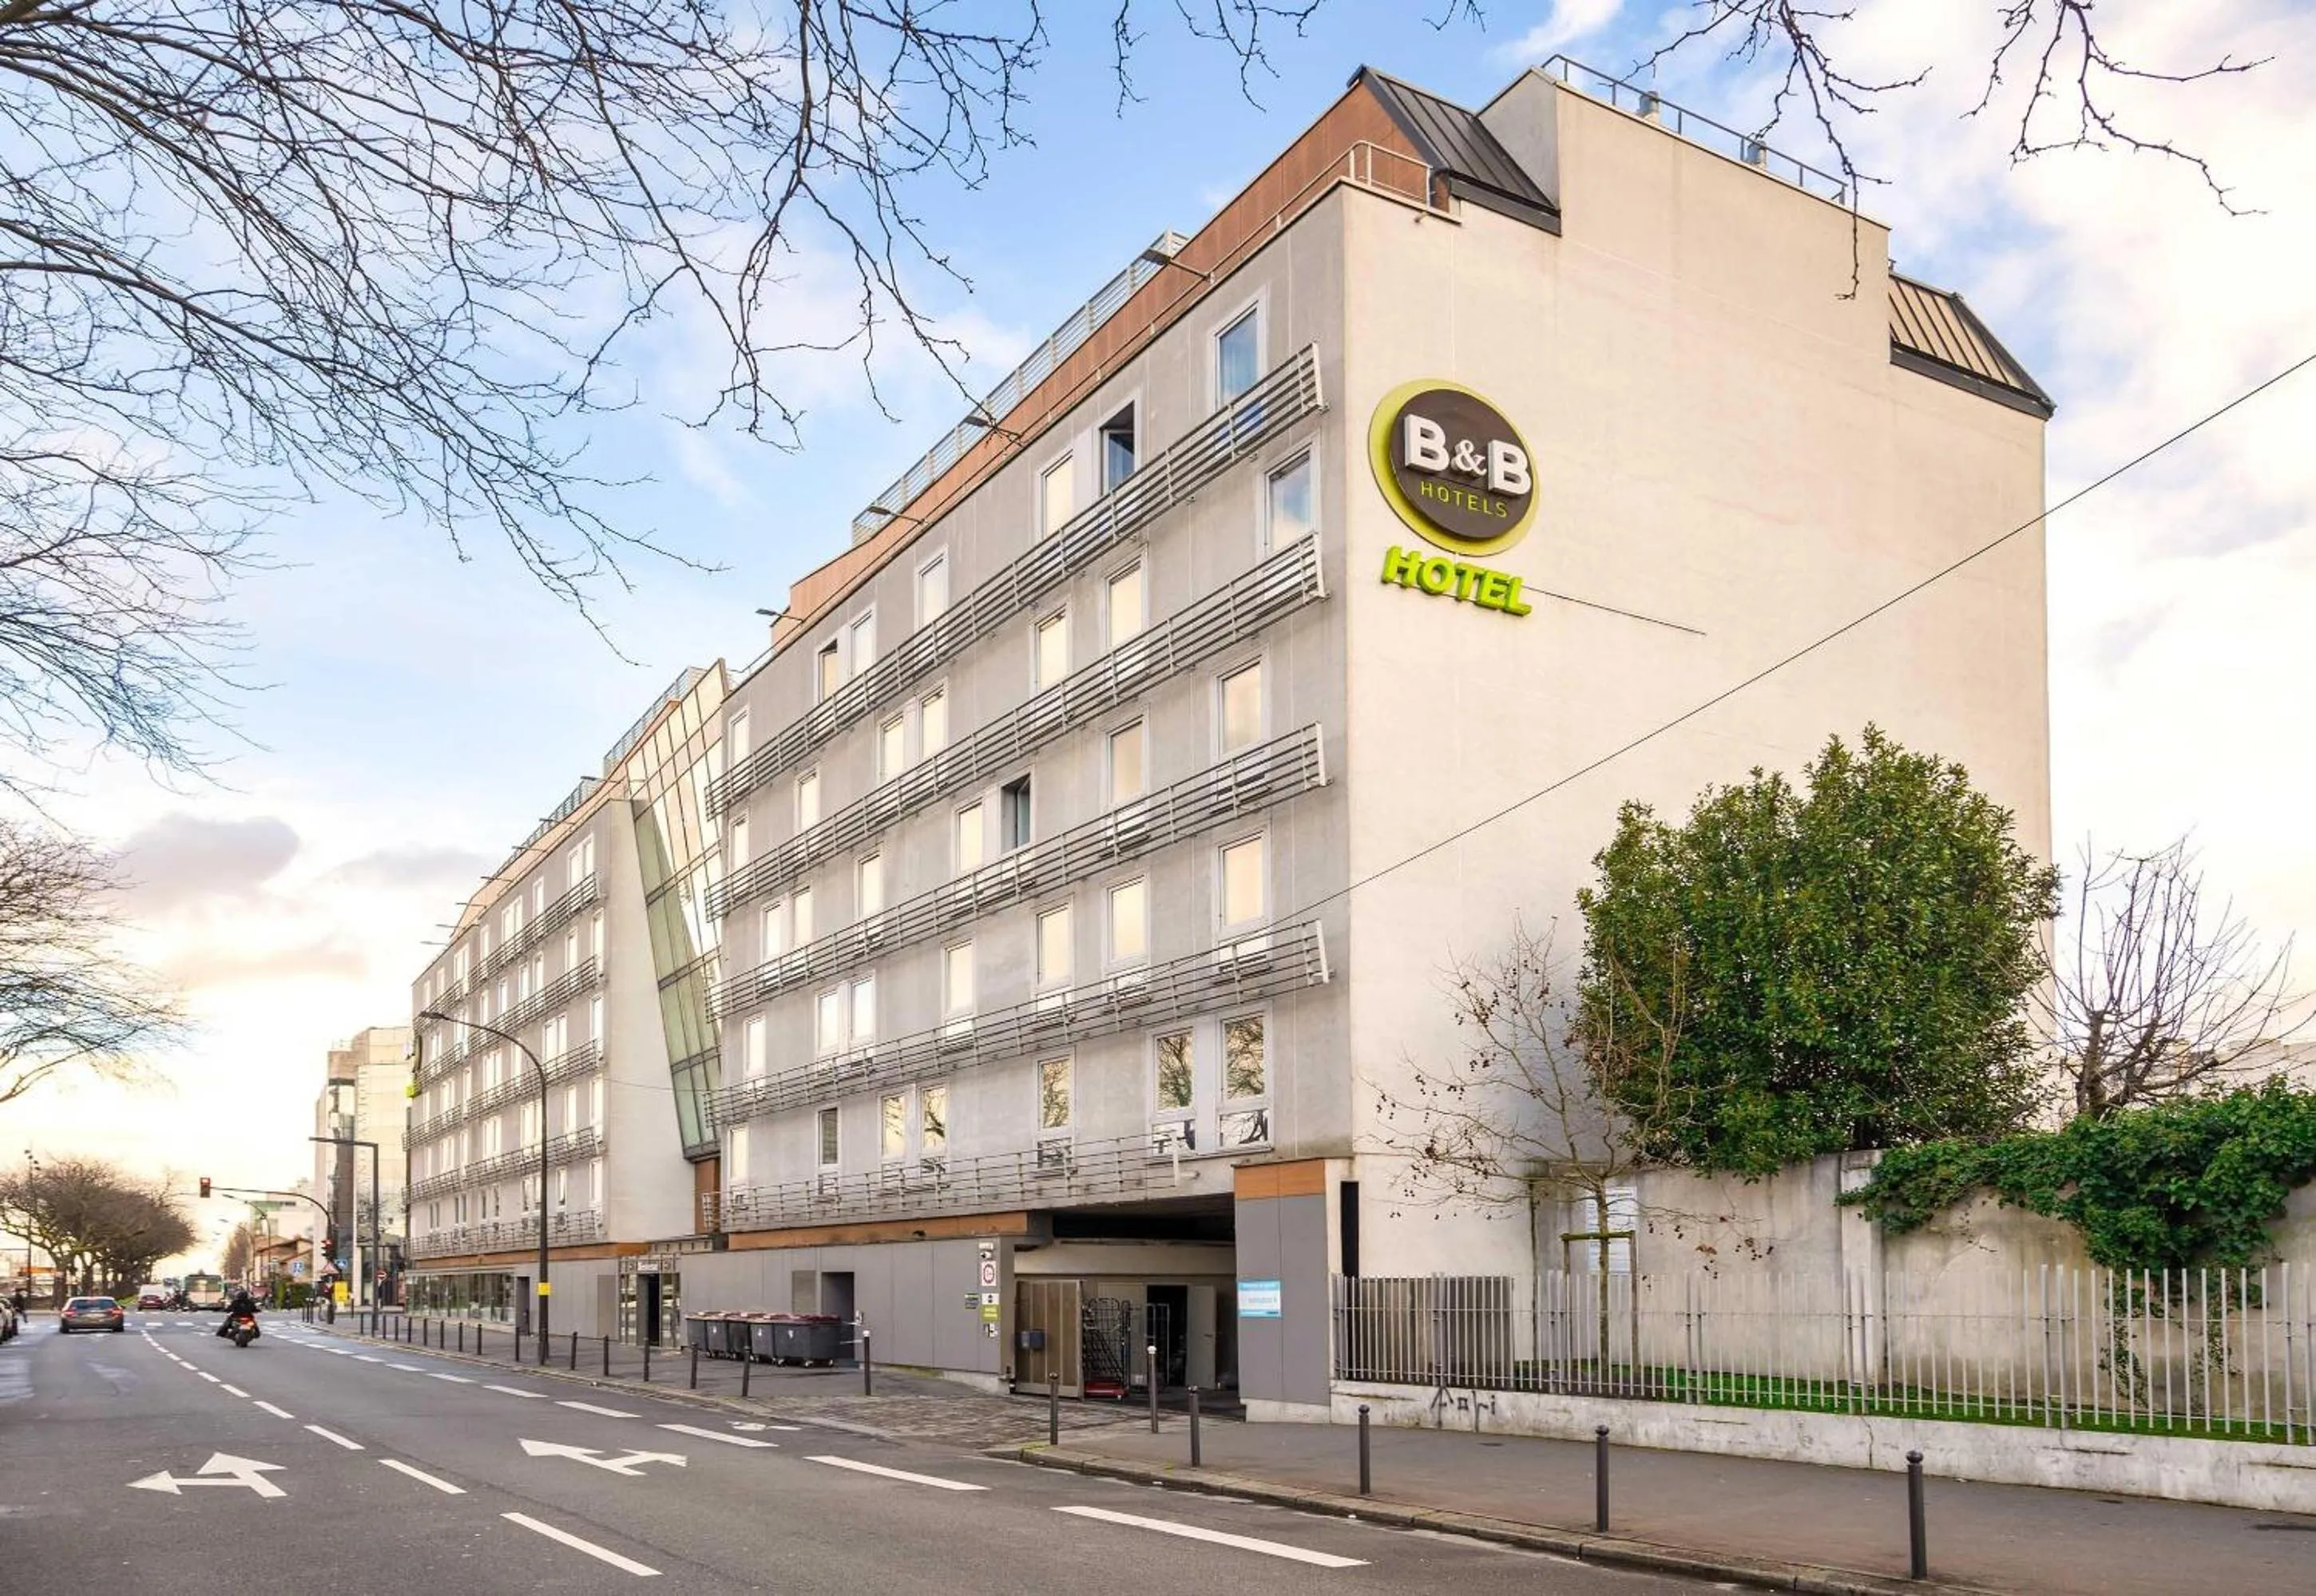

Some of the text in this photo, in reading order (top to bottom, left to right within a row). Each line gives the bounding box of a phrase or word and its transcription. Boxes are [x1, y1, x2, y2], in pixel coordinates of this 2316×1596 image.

[1405, 414, 1531, 495] B&B
[1421, 481, 1508, 518] HOTELS
[1382, 546, 1532, 615] HOTEL
